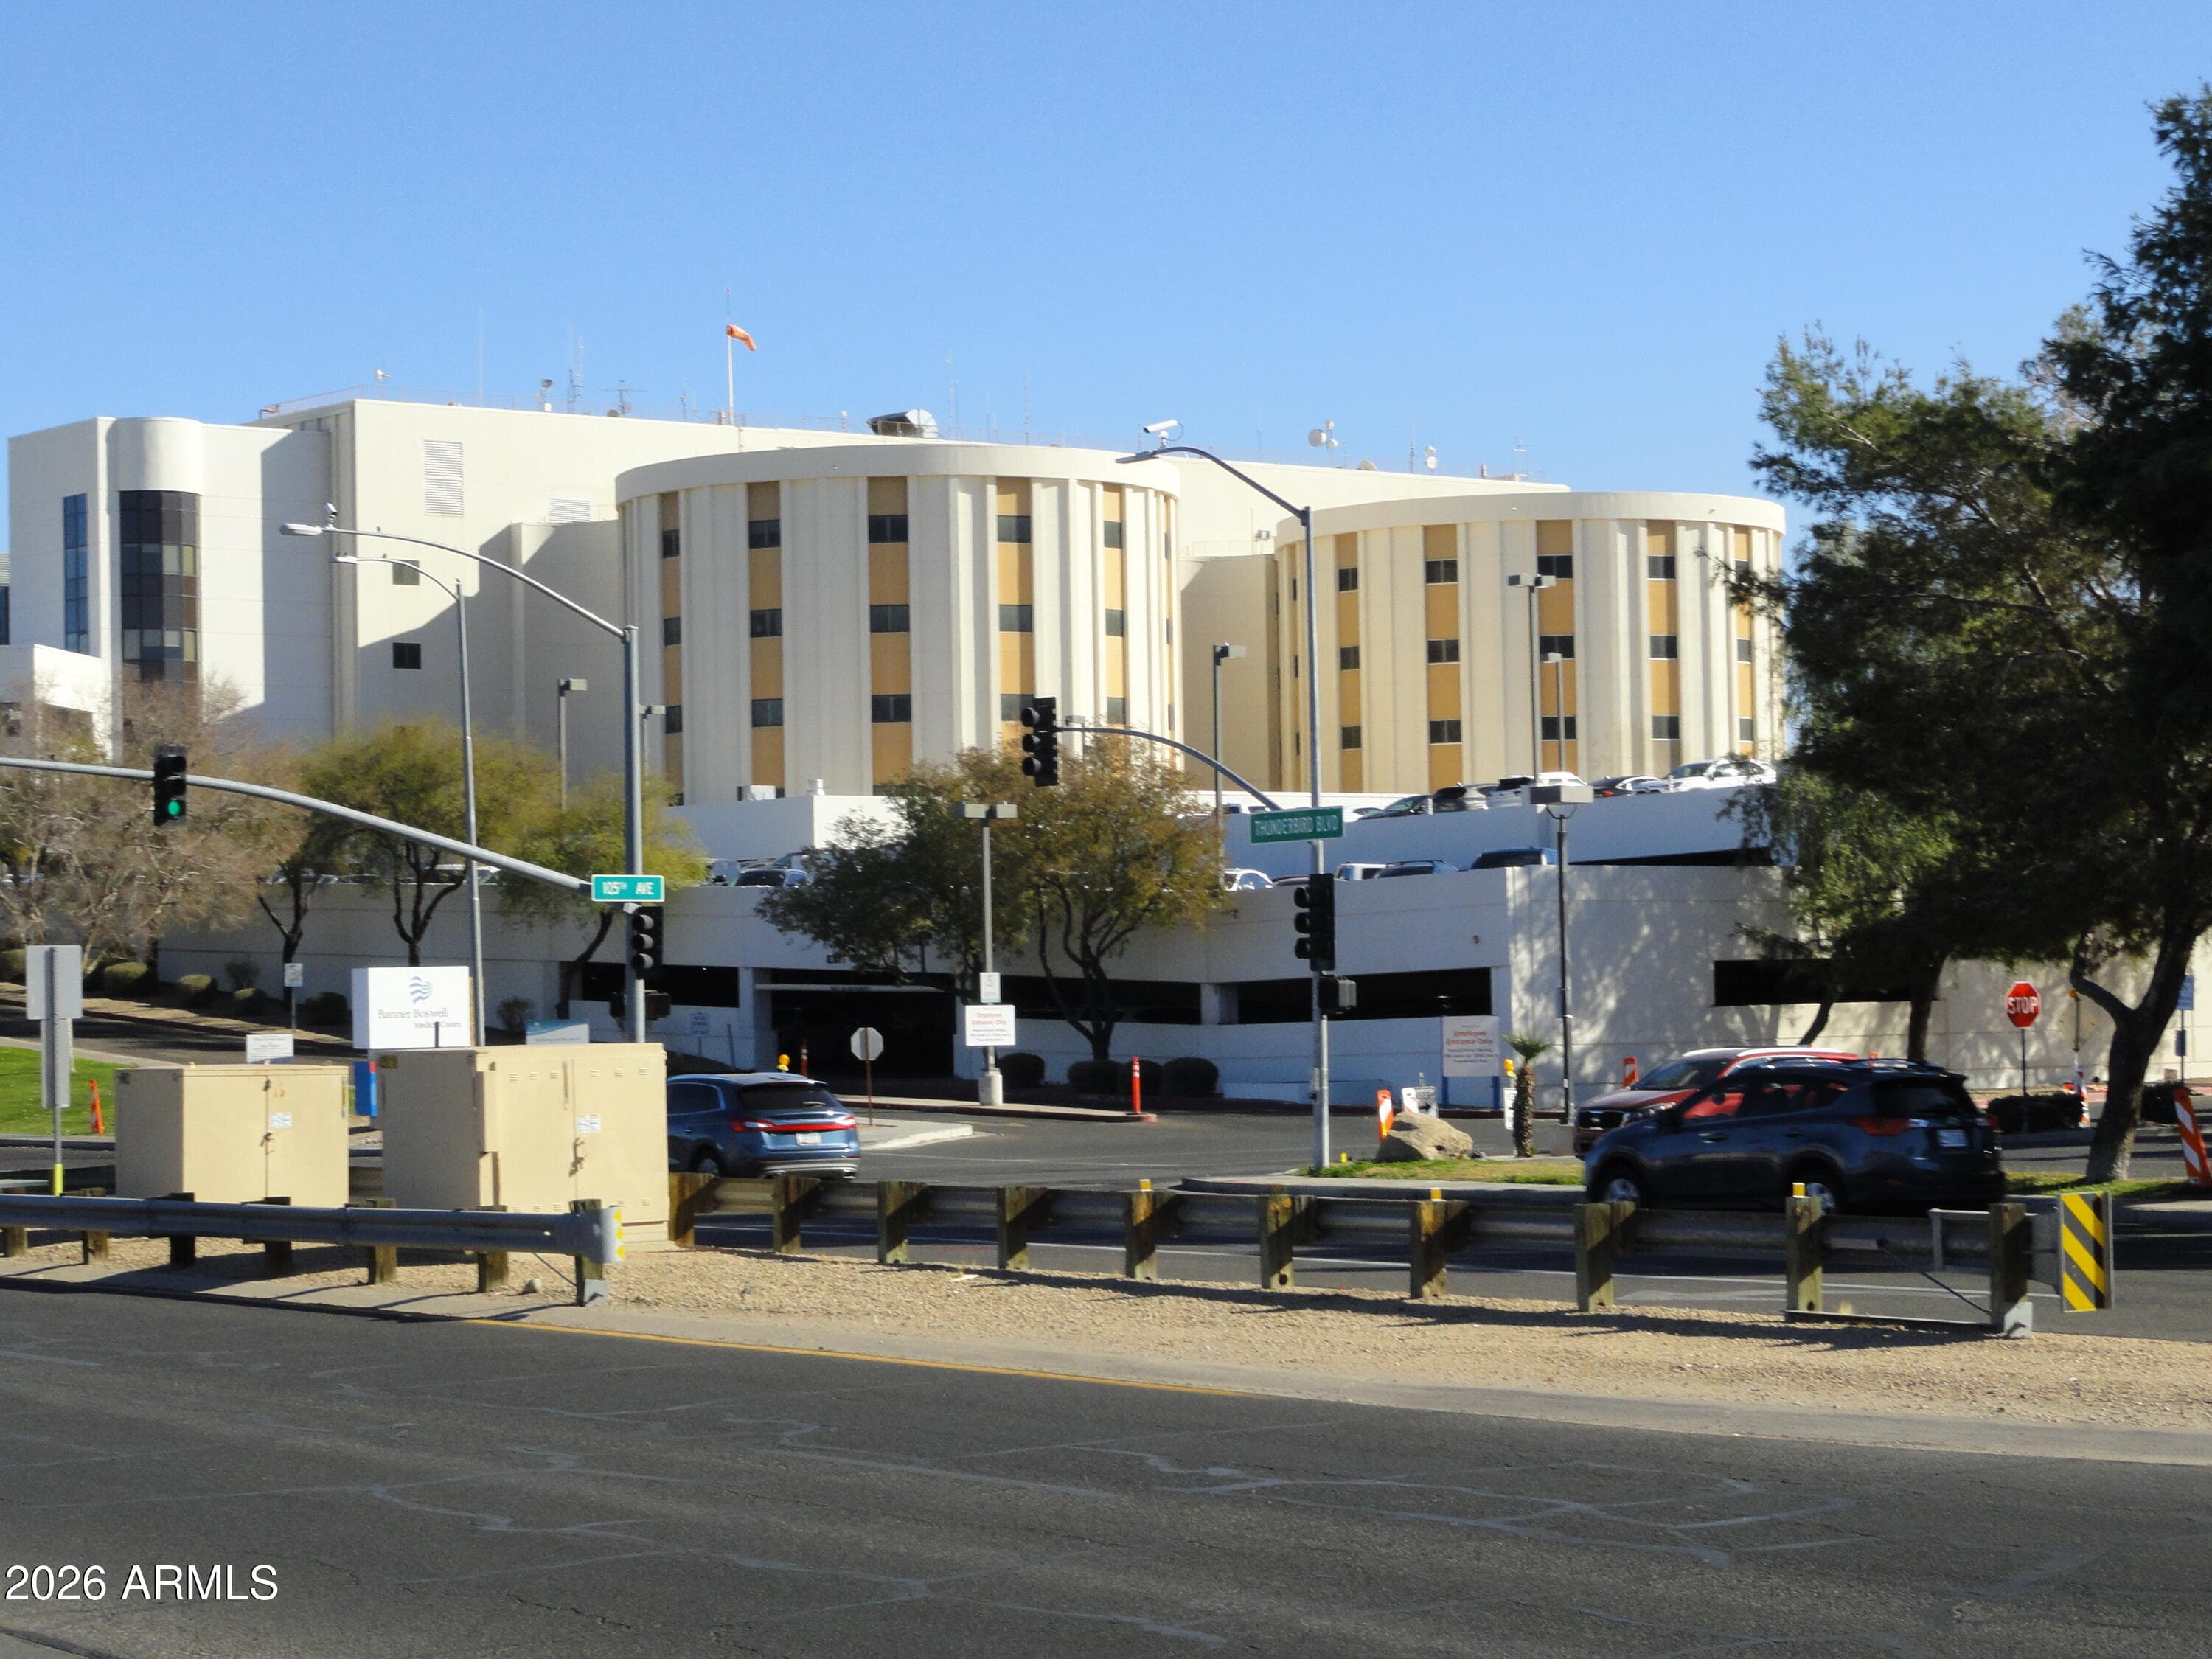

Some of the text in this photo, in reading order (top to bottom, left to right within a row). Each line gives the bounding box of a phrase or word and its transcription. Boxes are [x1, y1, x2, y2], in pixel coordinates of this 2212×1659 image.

[1254, 814, 1339, 836] THUNDERBIRD BLVD
[635, 881, 655, 895] AVE
[413, 1007, 448, 1018] Boswell
[2007, 996, 2038, 1014] STOP
